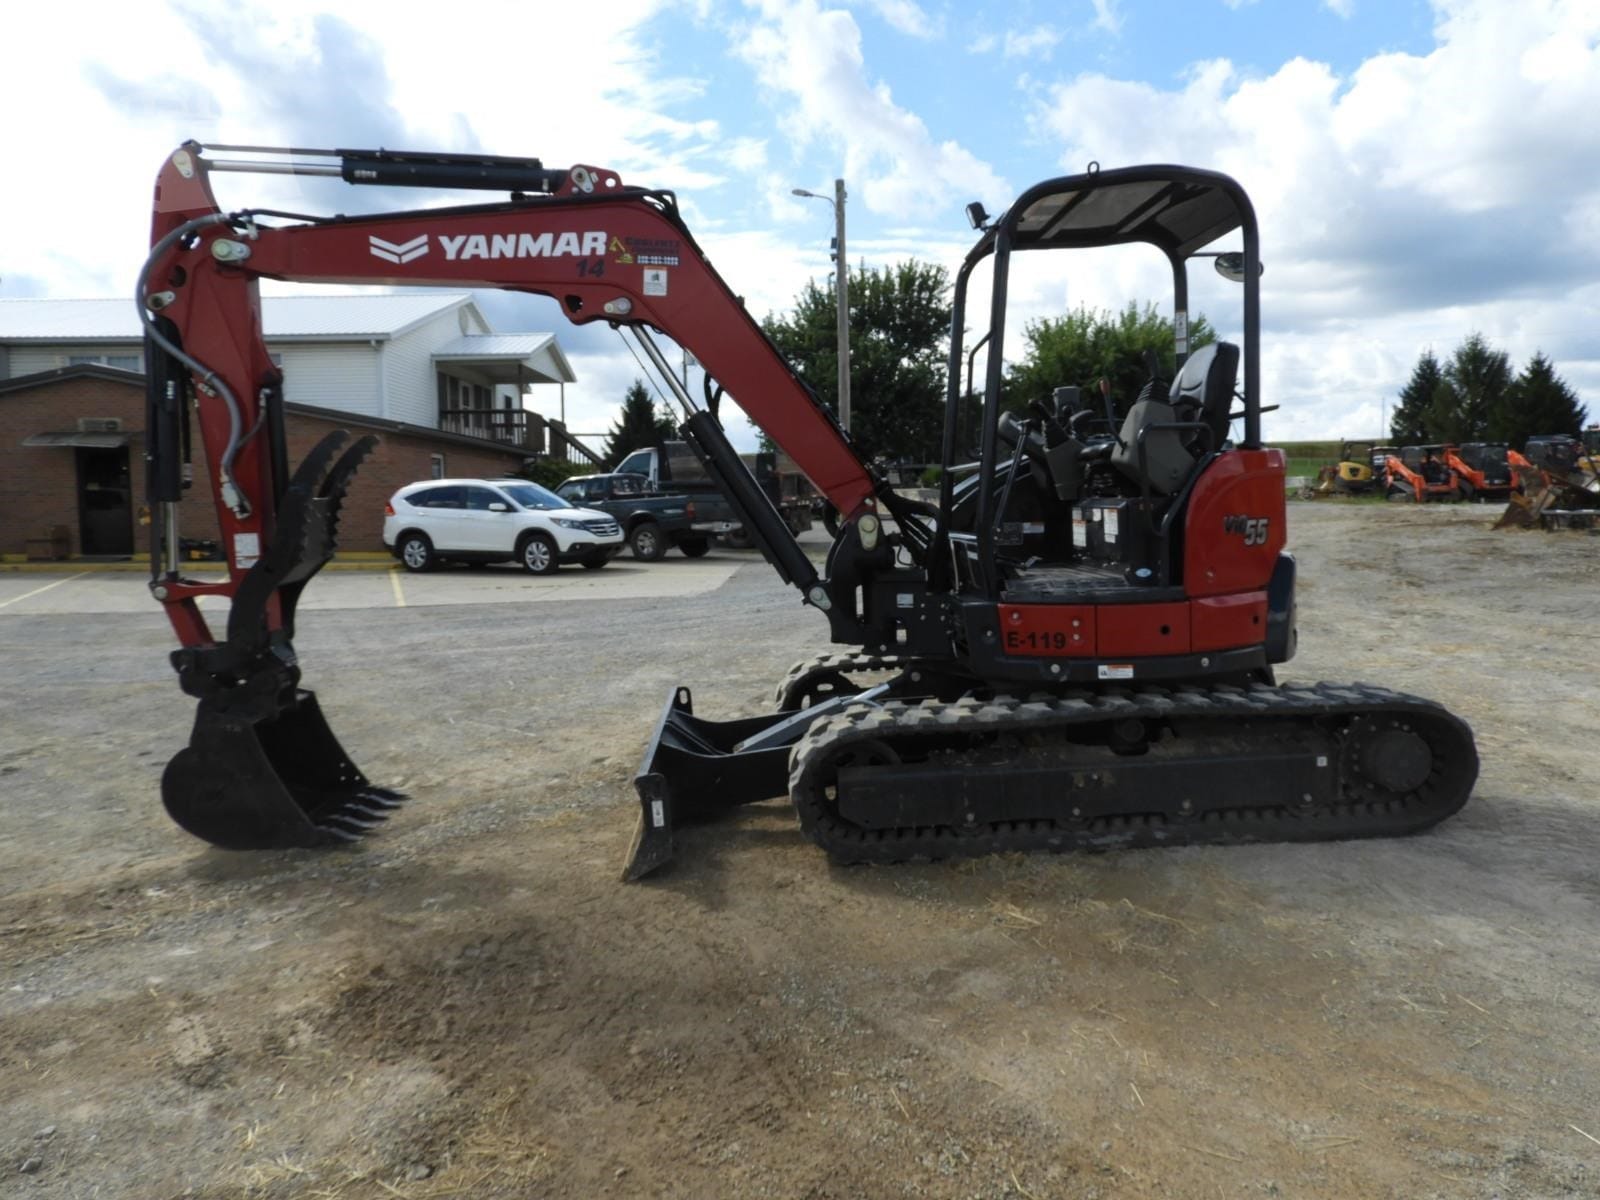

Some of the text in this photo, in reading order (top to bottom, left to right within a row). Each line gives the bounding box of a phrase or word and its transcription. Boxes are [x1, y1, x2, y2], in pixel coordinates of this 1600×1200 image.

[438, 231, 607, 260] YANMAR
[576, 260, 606, 278] 14
[1007, 631, 1067, 650] E-119
